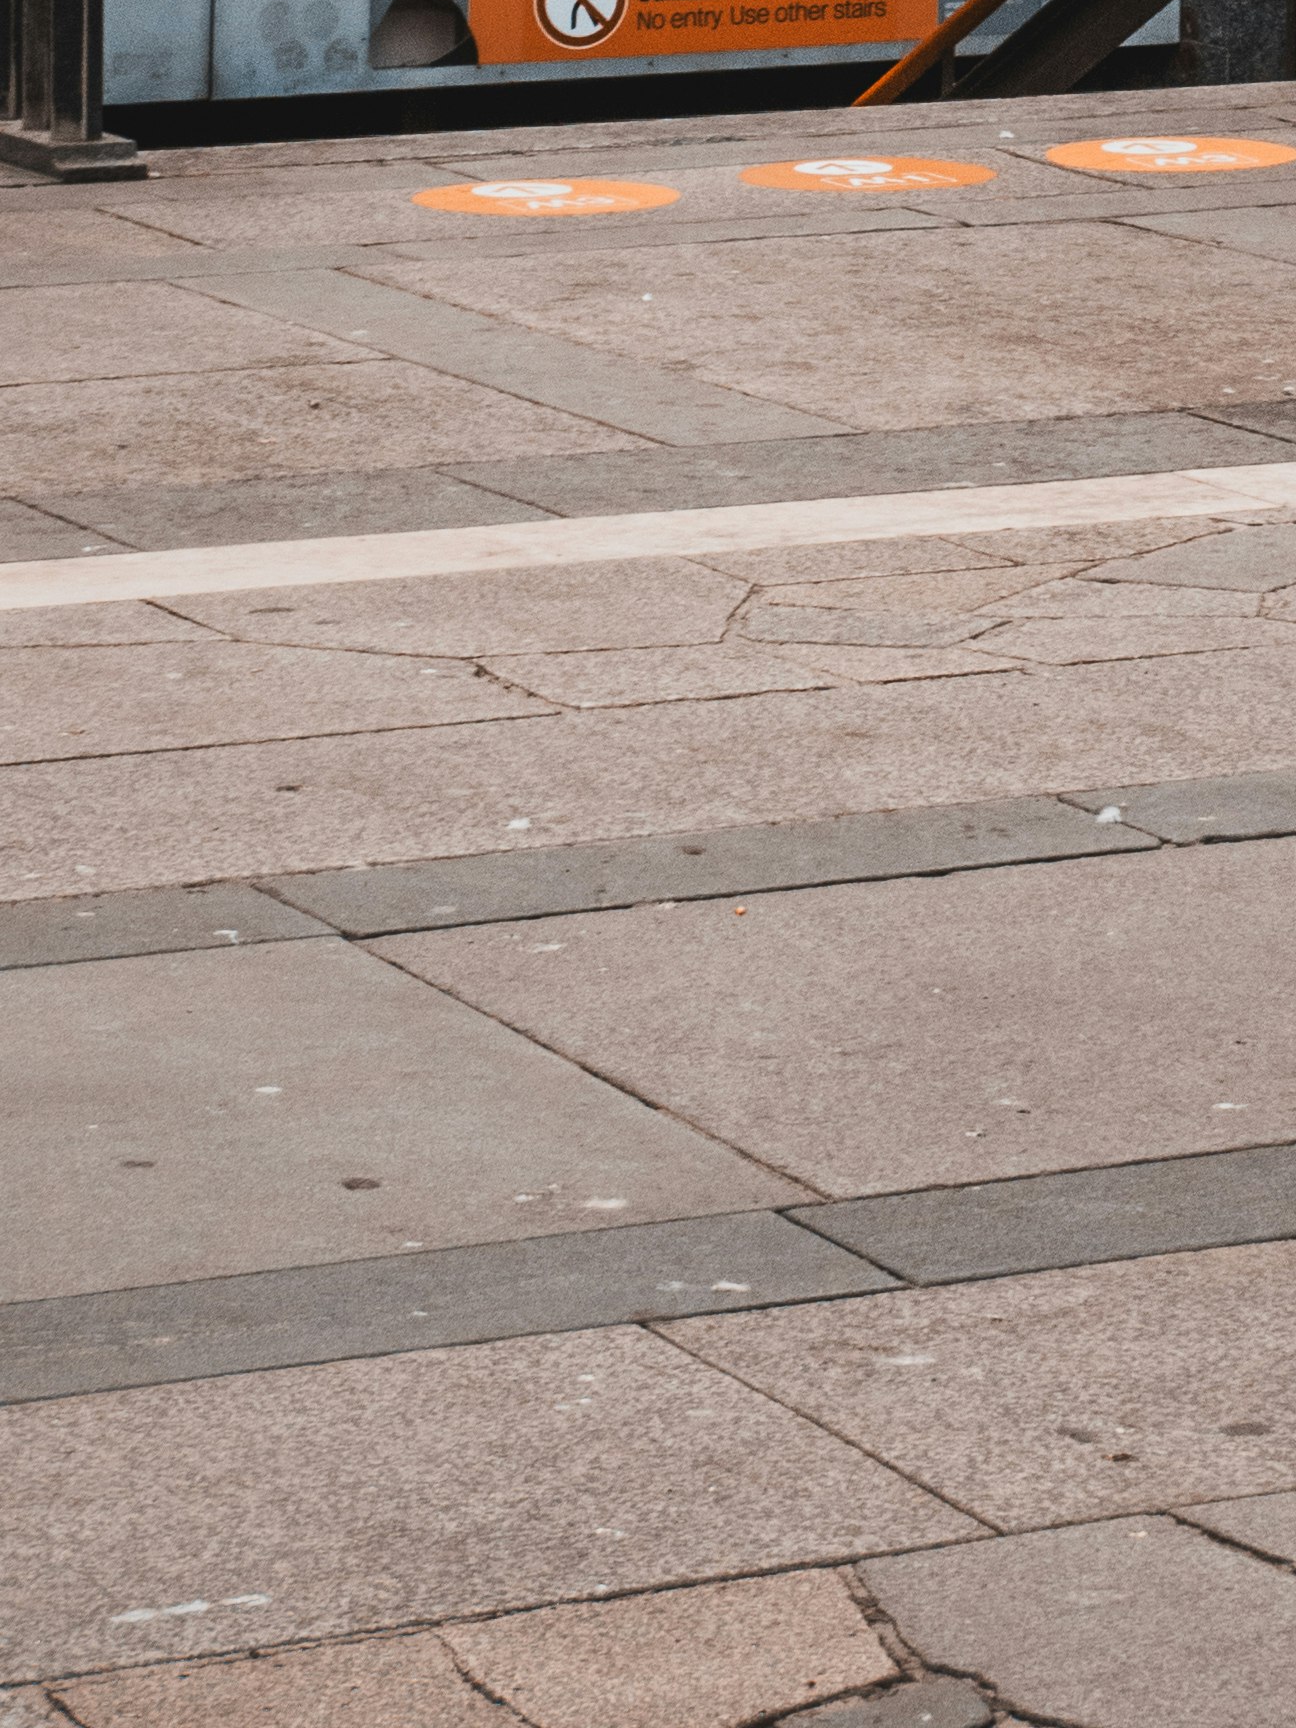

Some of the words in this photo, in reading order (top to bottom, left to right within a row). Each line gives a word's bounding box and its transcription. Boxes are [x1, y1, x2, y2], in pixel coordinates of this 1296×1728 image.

[637, 11, 666, 31] No
[730, 5, 770, 25] Use
[775, 3, 828, 22] other
